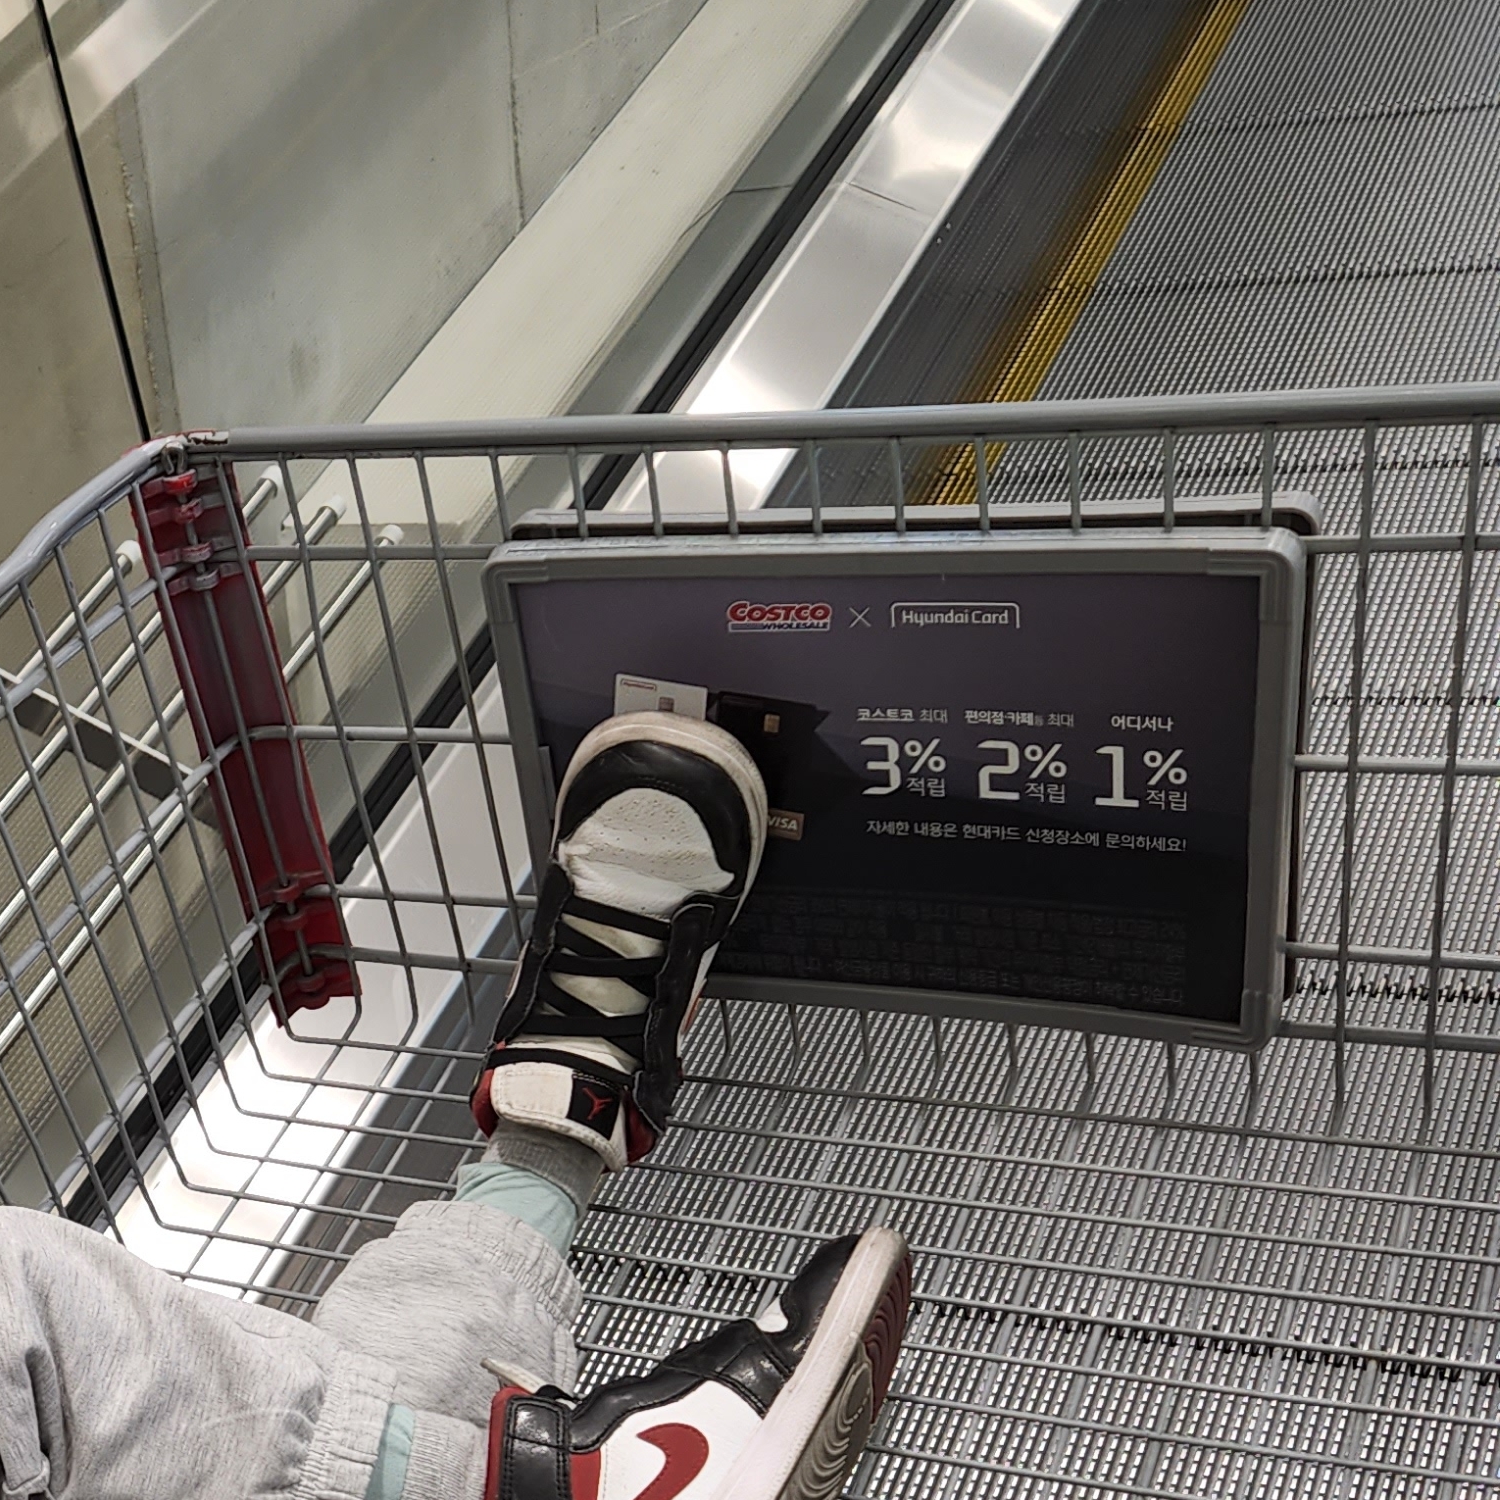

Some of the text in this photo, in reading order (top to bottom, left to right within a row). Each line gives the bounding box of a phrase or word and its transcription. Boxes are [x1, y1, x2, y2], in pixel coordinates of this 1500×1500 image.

[727, 601, 832, 623] COSTCO
[902, 609, 1009, 626] Hyundai Card
[857, 708, 949, 724] 코스트코 최대
[1047, 713, 1075, 728] 최대
[1111, 715, 1174, 732] 어디서나
[860, 736, 947, 796] 3%
[977, 739, 1068, 801] 2%
[1094, 745, 1188, 808] 1%
[906, 777, 946, 798] 적립
[1025, 782, 1066, 804] 적립
[1145, 789, 1188, 812] 적립
[866, 820, 1187, 852] 자세한 내용은 현대카드 신청장소에 문의하세요!
